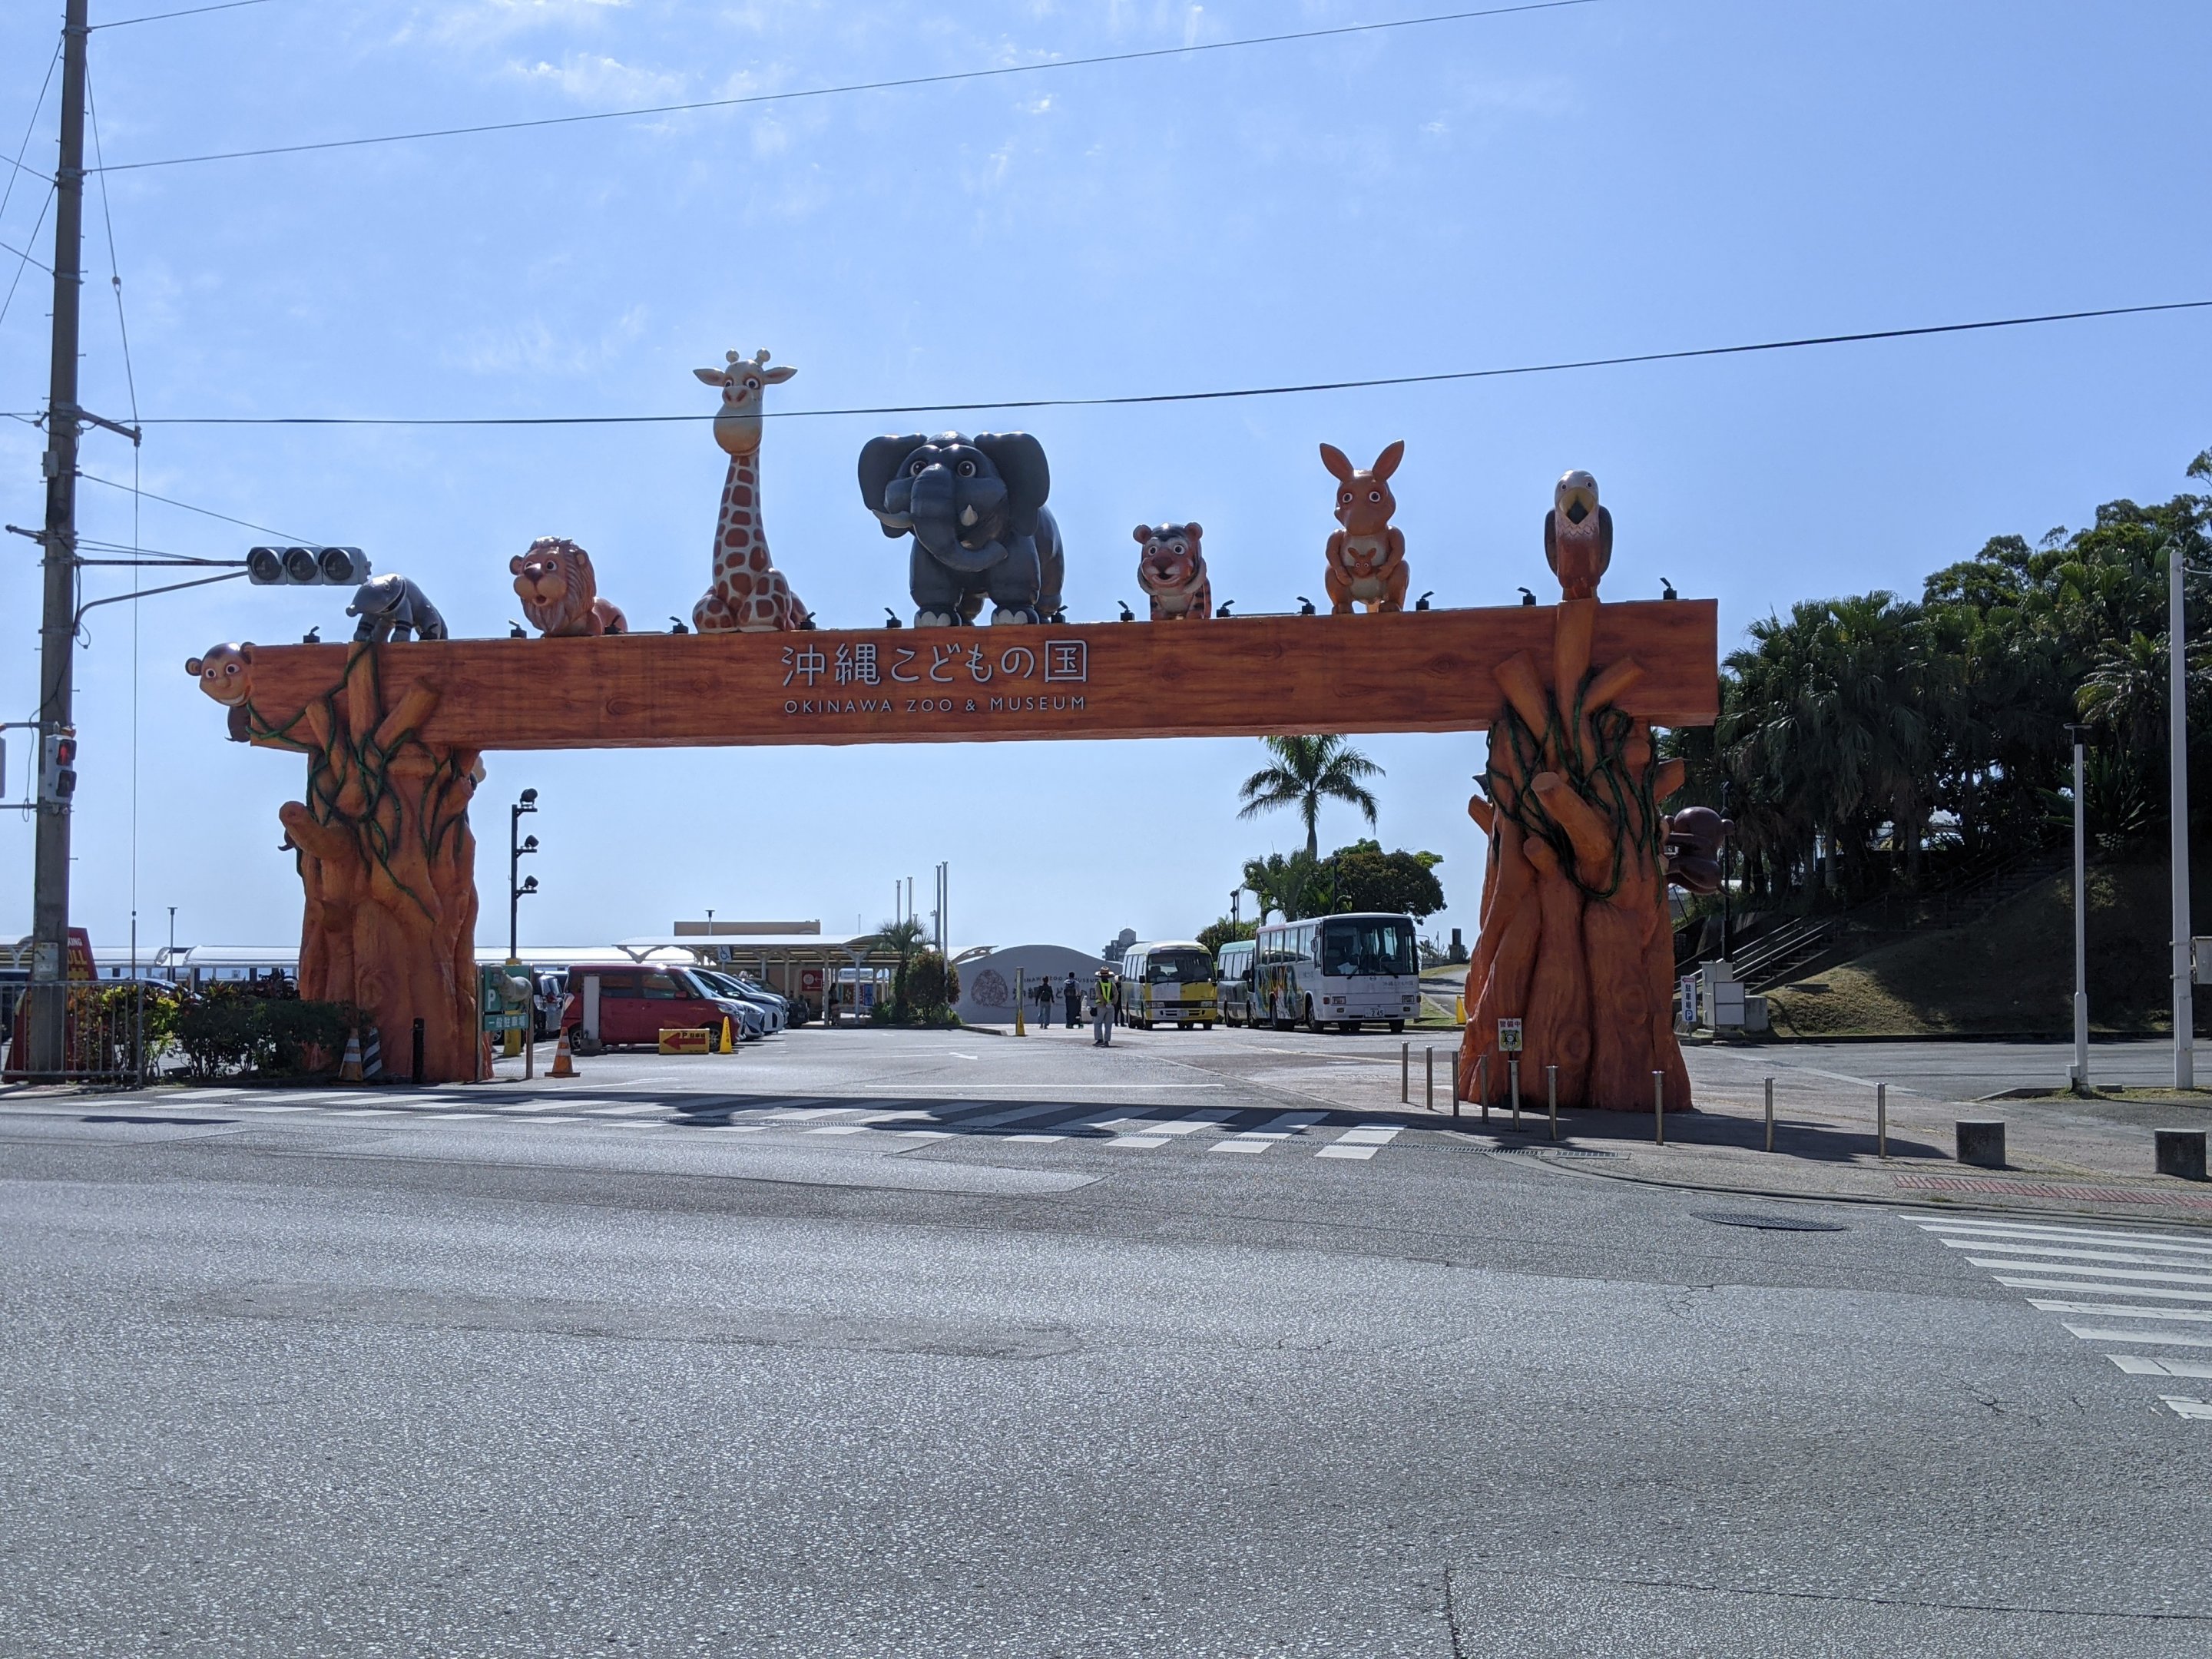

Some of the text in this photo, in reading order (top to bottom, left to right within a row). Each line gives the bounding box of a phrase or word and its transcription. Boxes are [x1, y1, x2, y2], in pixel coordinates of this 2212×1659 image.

[782, 639, 1088, 687] 沖縄こどもの国
[784, 695, 1084, 714] OKINAWA ZOO & MUSEUM
[488, 988, 496, 1010] P
[488, 1015, 526, 1028] 一般駐車場
